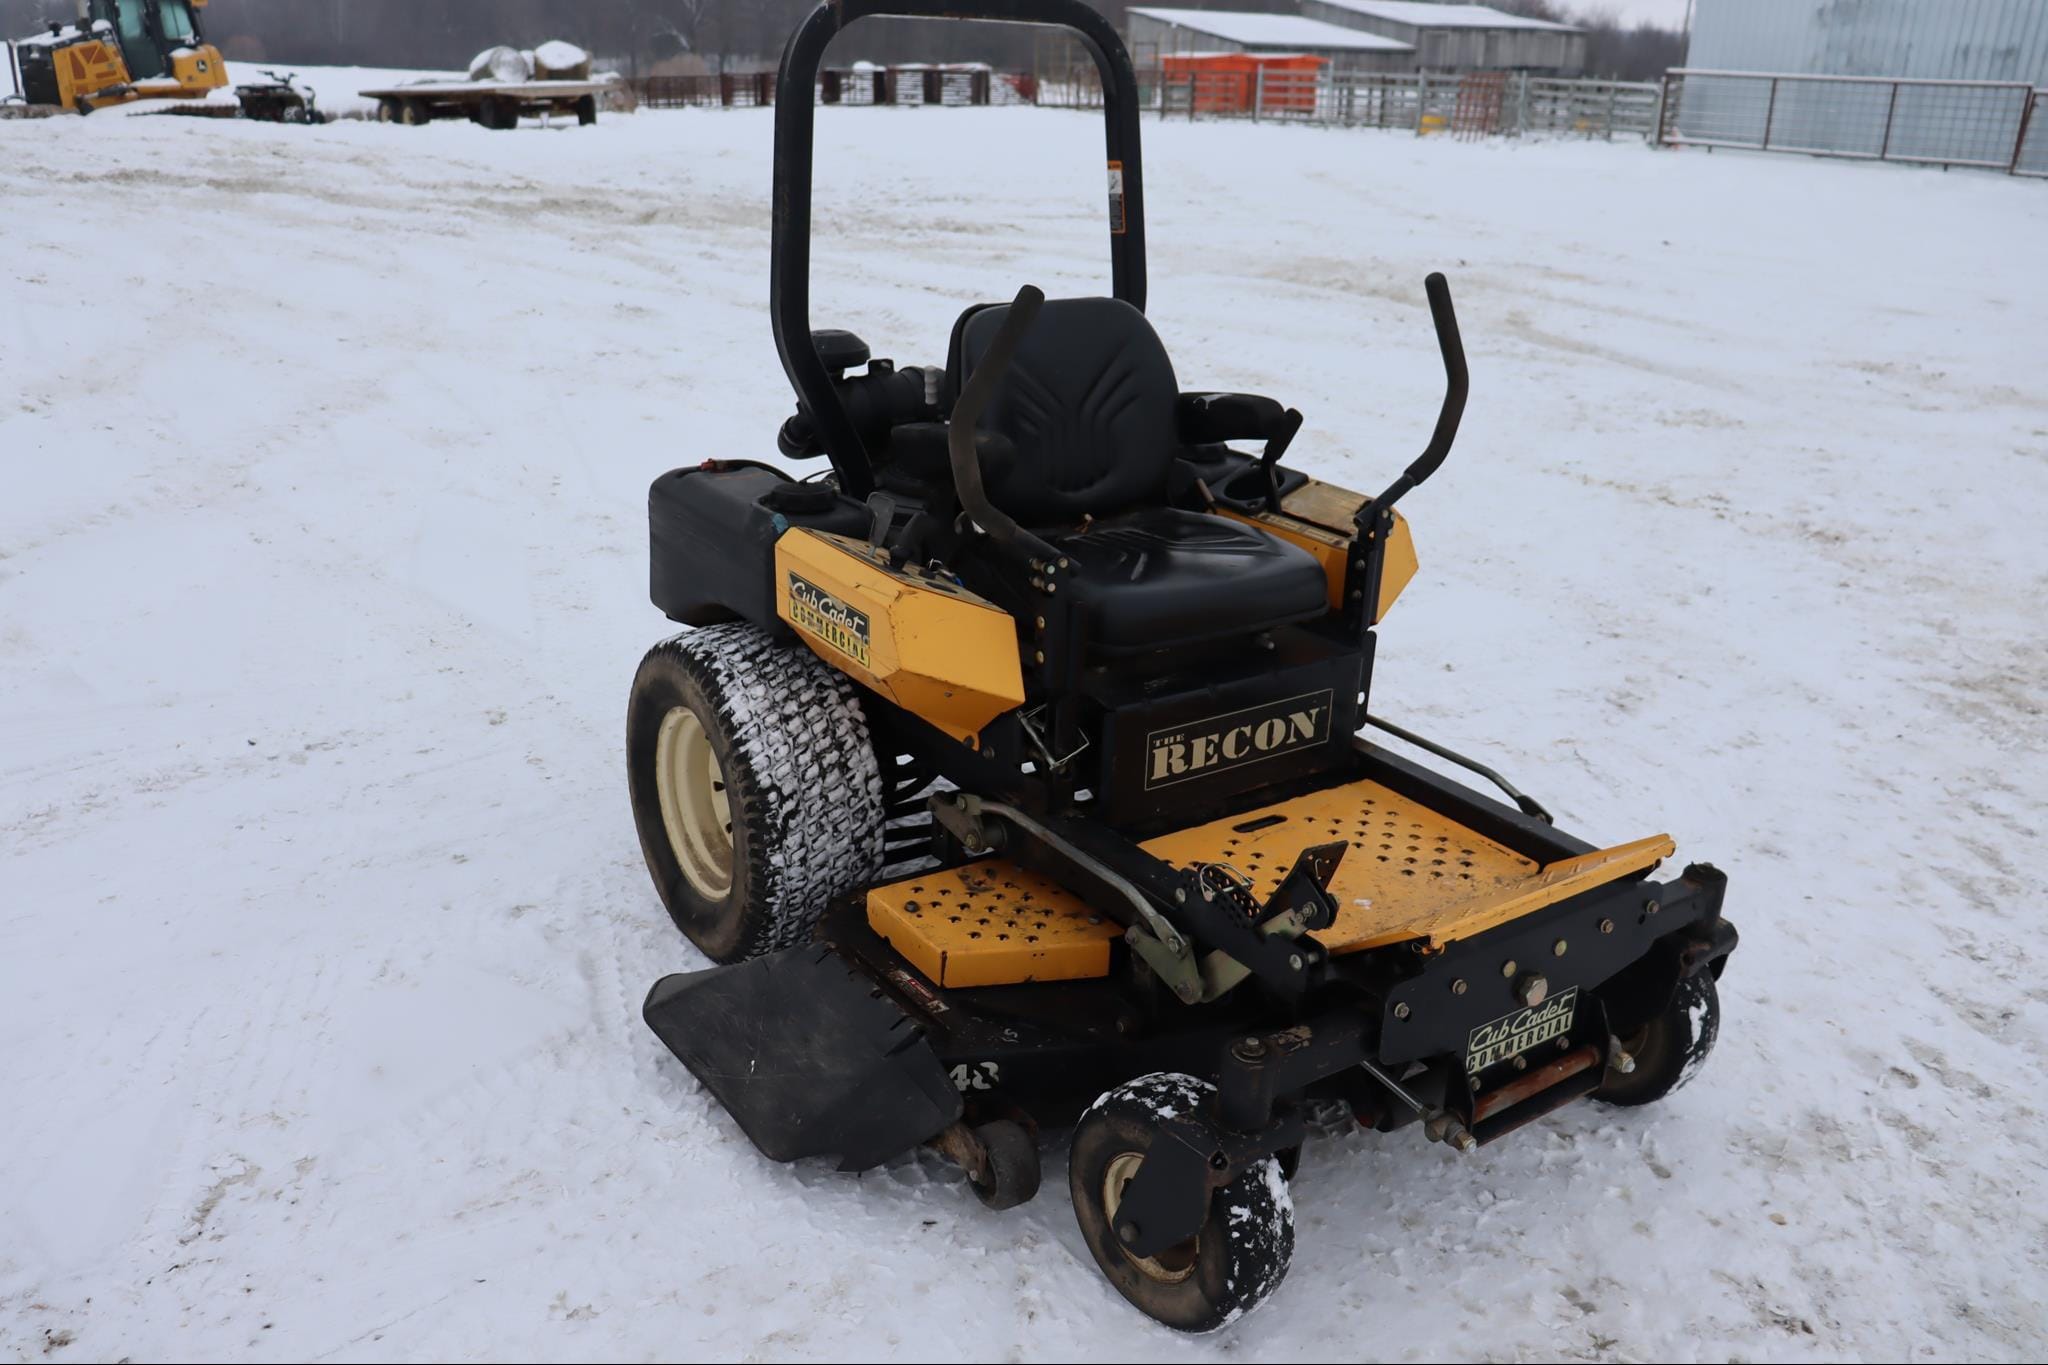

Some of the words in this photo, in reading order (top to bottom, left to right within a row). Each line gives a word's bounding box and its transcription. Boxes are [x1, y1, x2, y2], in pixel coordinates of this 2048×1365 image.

[793, 581, 818, 610] Cub
[819, 597, 865, 638] Cadet
[1151, 708, 1320, 780] RECON
[1152, 733, 1185, 748] THE
[1467, 1014, 1571, 1072] COMMERCIAL
[1470, 1018, 1510, 1052] Cub
[1511, 993, 1575, 1034] Cadet
